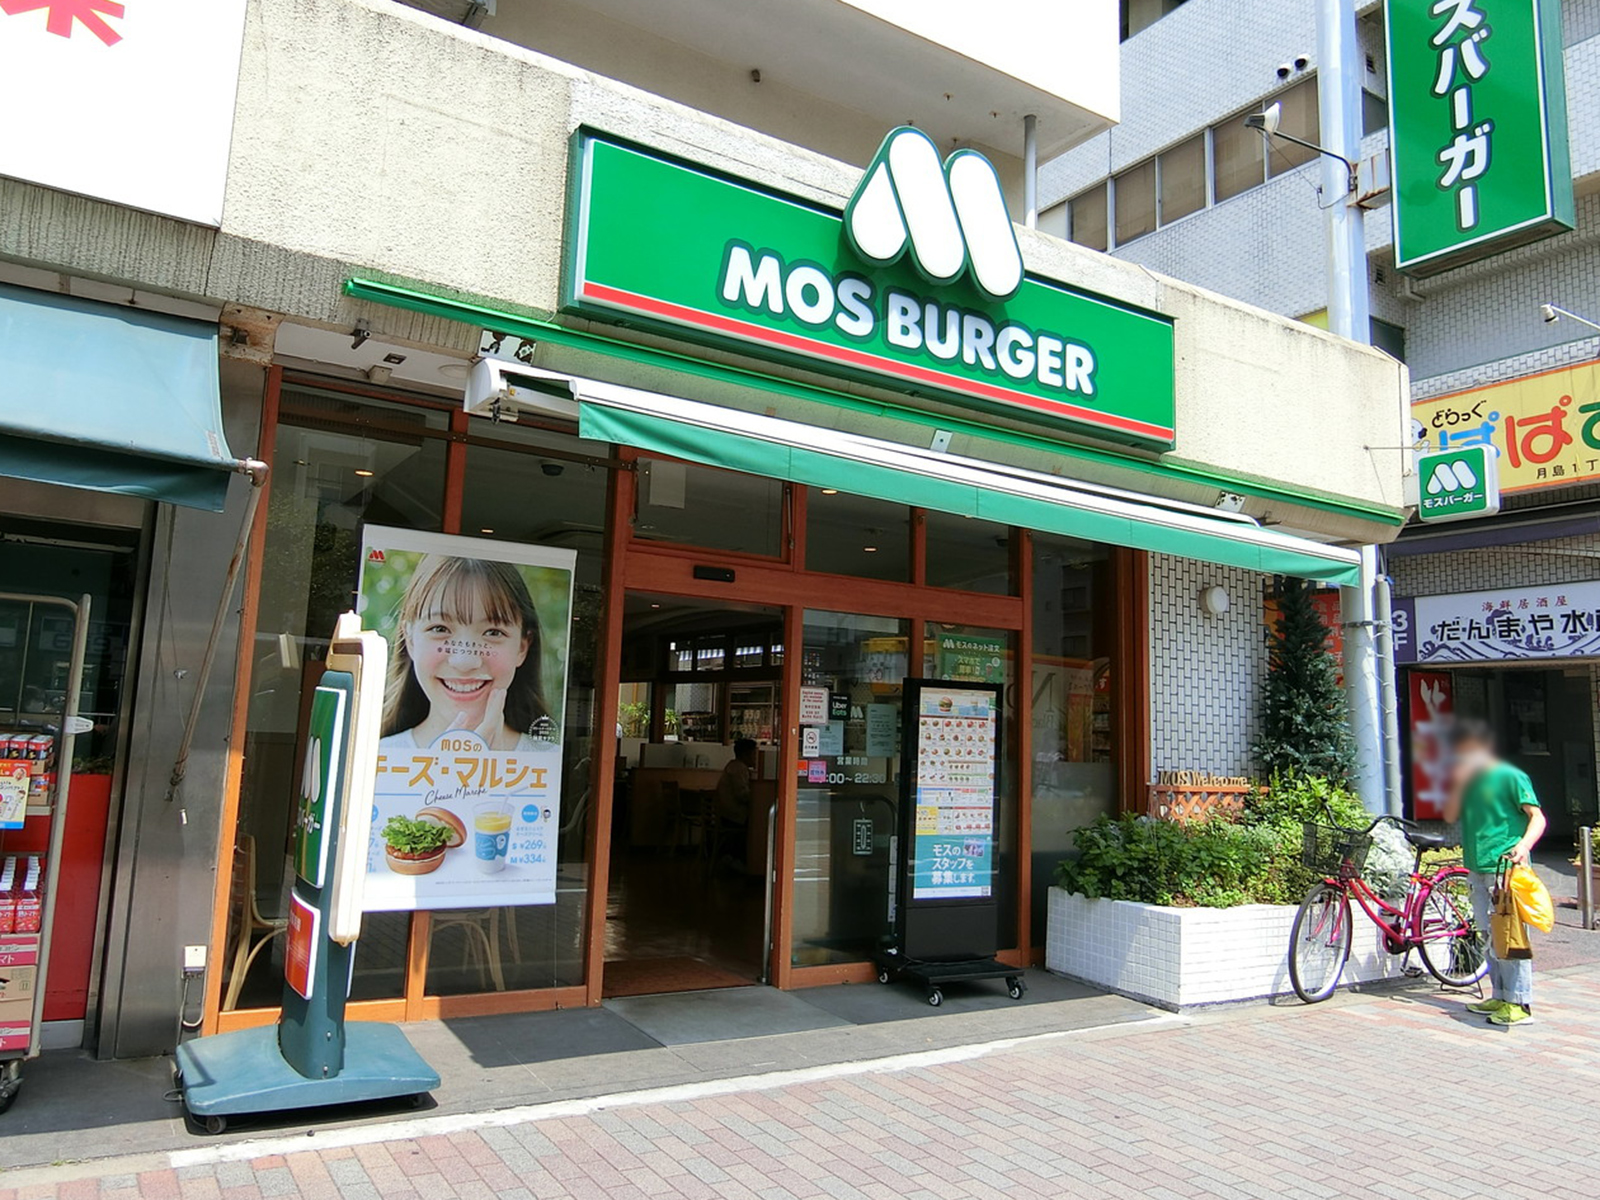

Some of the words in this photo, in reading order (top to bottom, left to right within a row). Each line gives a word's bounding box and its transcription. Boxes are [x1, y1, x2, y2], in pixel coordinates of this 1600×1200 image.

[1432, 0, 1491, 229] スバーガー
[722, 245, 875, 337] MOS
[886, 292, 1094, 395] BURGER
[1431, 399, 1488, 429] どらっぐ
[1423, 491, 1484, 509] モスバーガー
[1480, 594, 1568, 613] 海鮮居酒屋
[1436, 609, 1600, 643] だんまや水
[441, 738, 482, 752] MOSの
[932, 844, 962, 858] モスの
[931, 857, 975, 871] スタッフを
